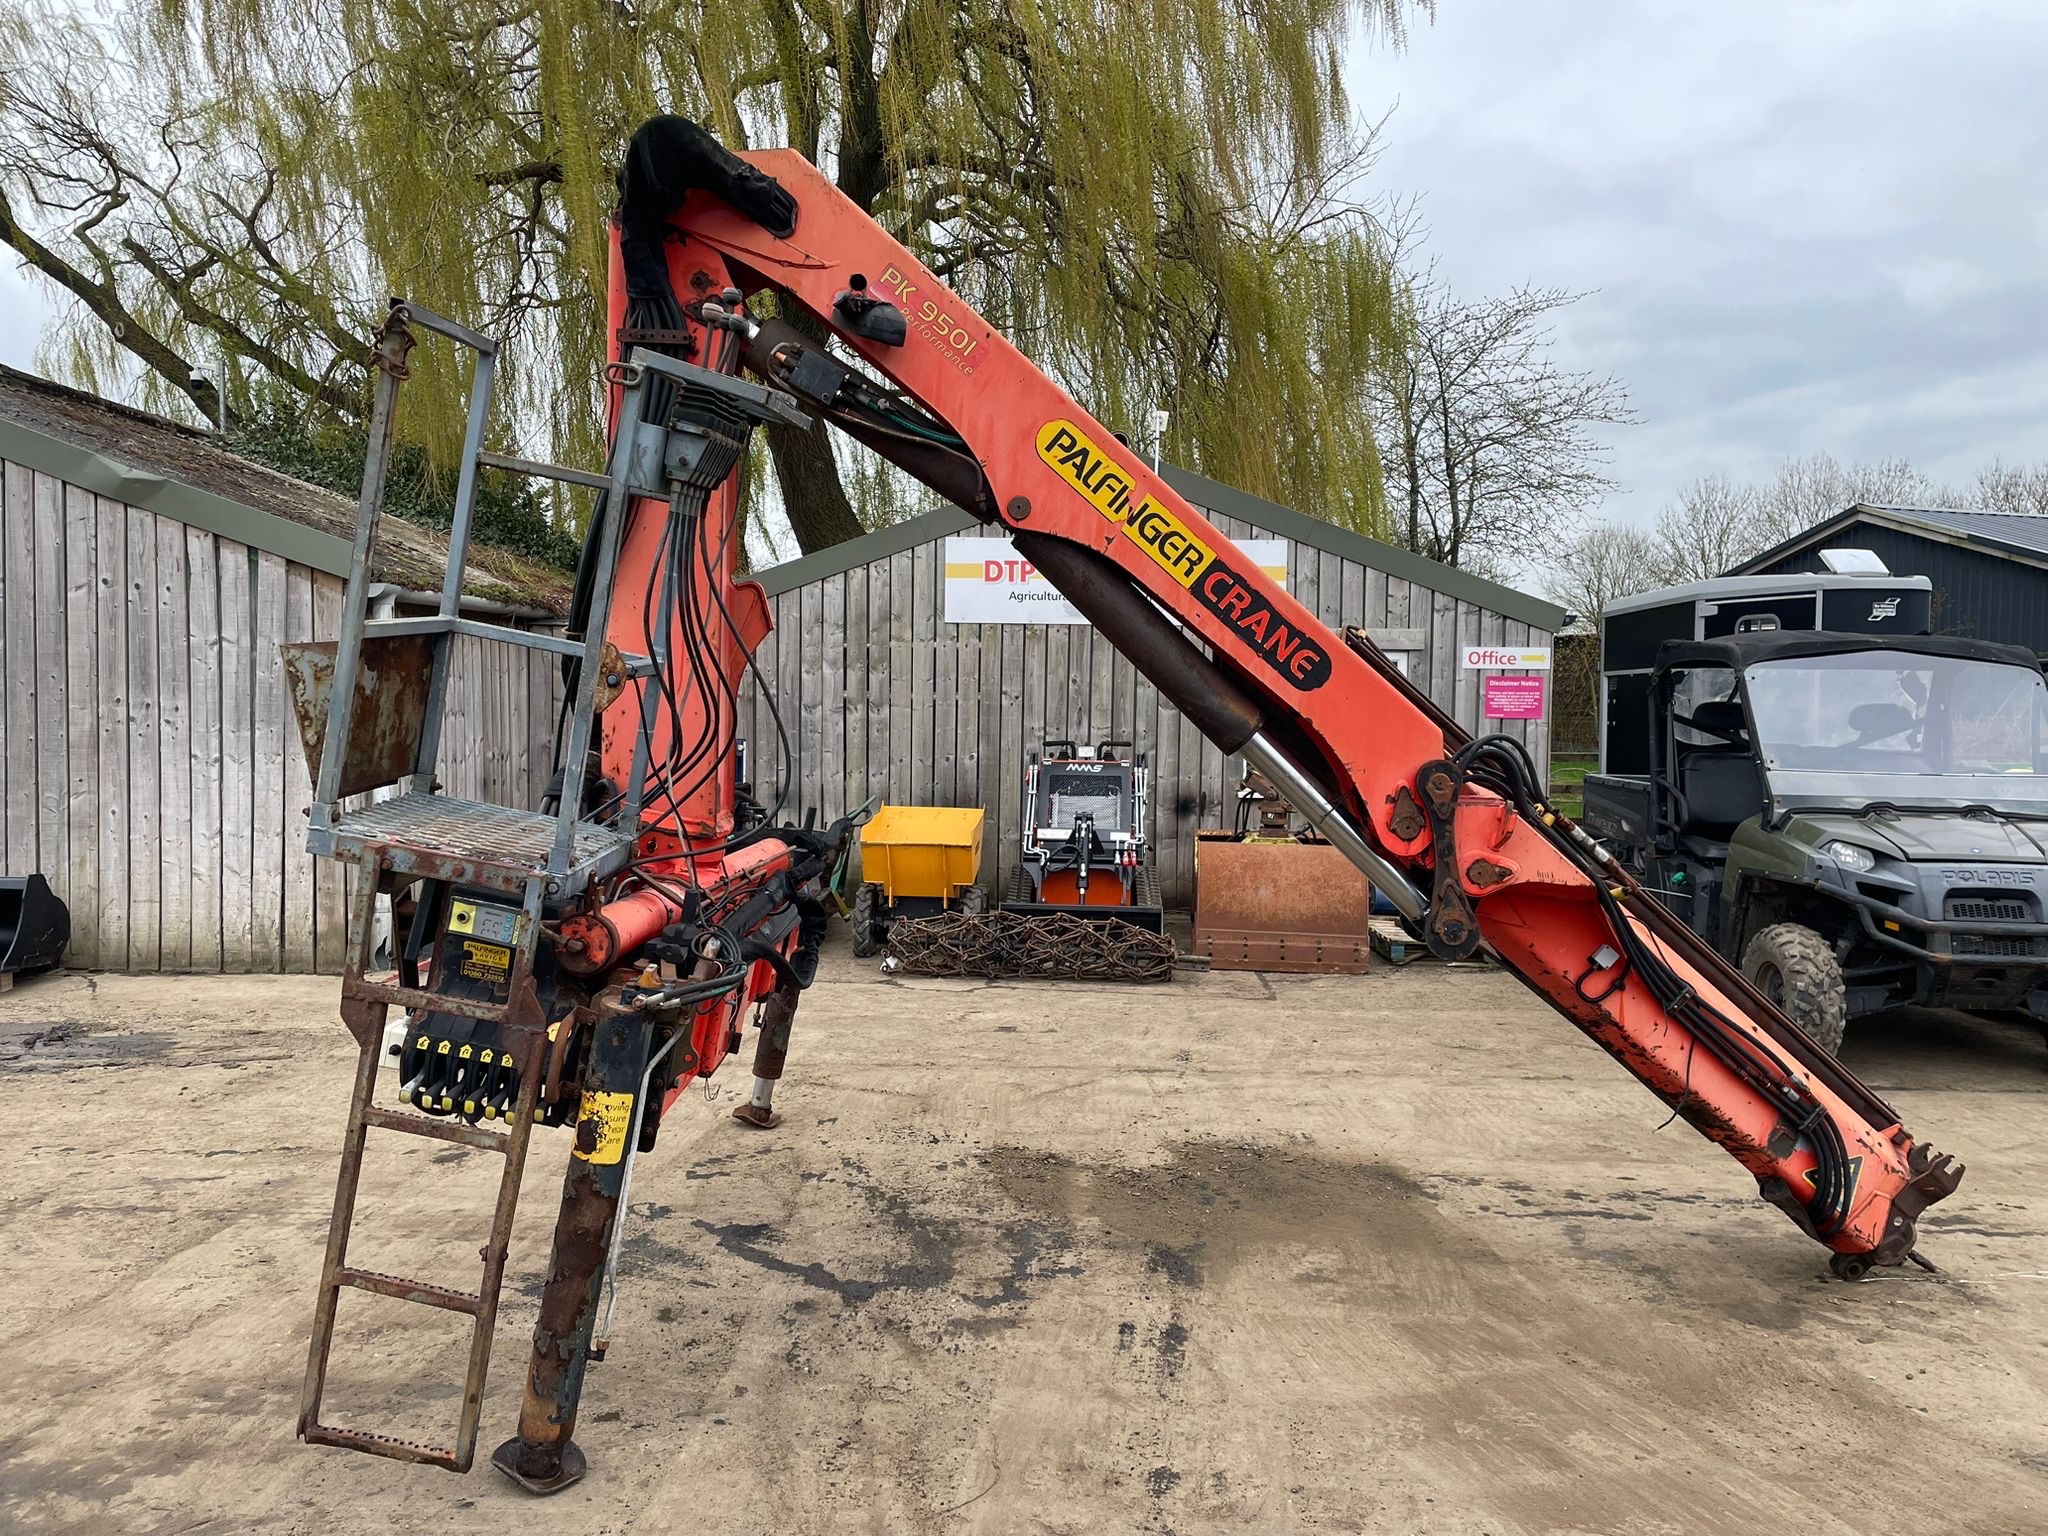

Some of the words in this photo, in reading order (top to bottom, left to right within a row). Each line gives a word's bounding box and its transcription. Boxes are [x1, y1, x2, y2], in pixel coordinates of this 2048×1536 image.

[880, 266, 918, 304] PK
[900, 307, 973, 375] Performance
[1045, 427, 1205, 578] PALFINGER
[1203, 571, 1321, 680] CRANE
[984, 560, 1036, 583] DTP
[1468, 651, 1517, 665] Office
[1941, 870, 2035, 885] POLARIS
